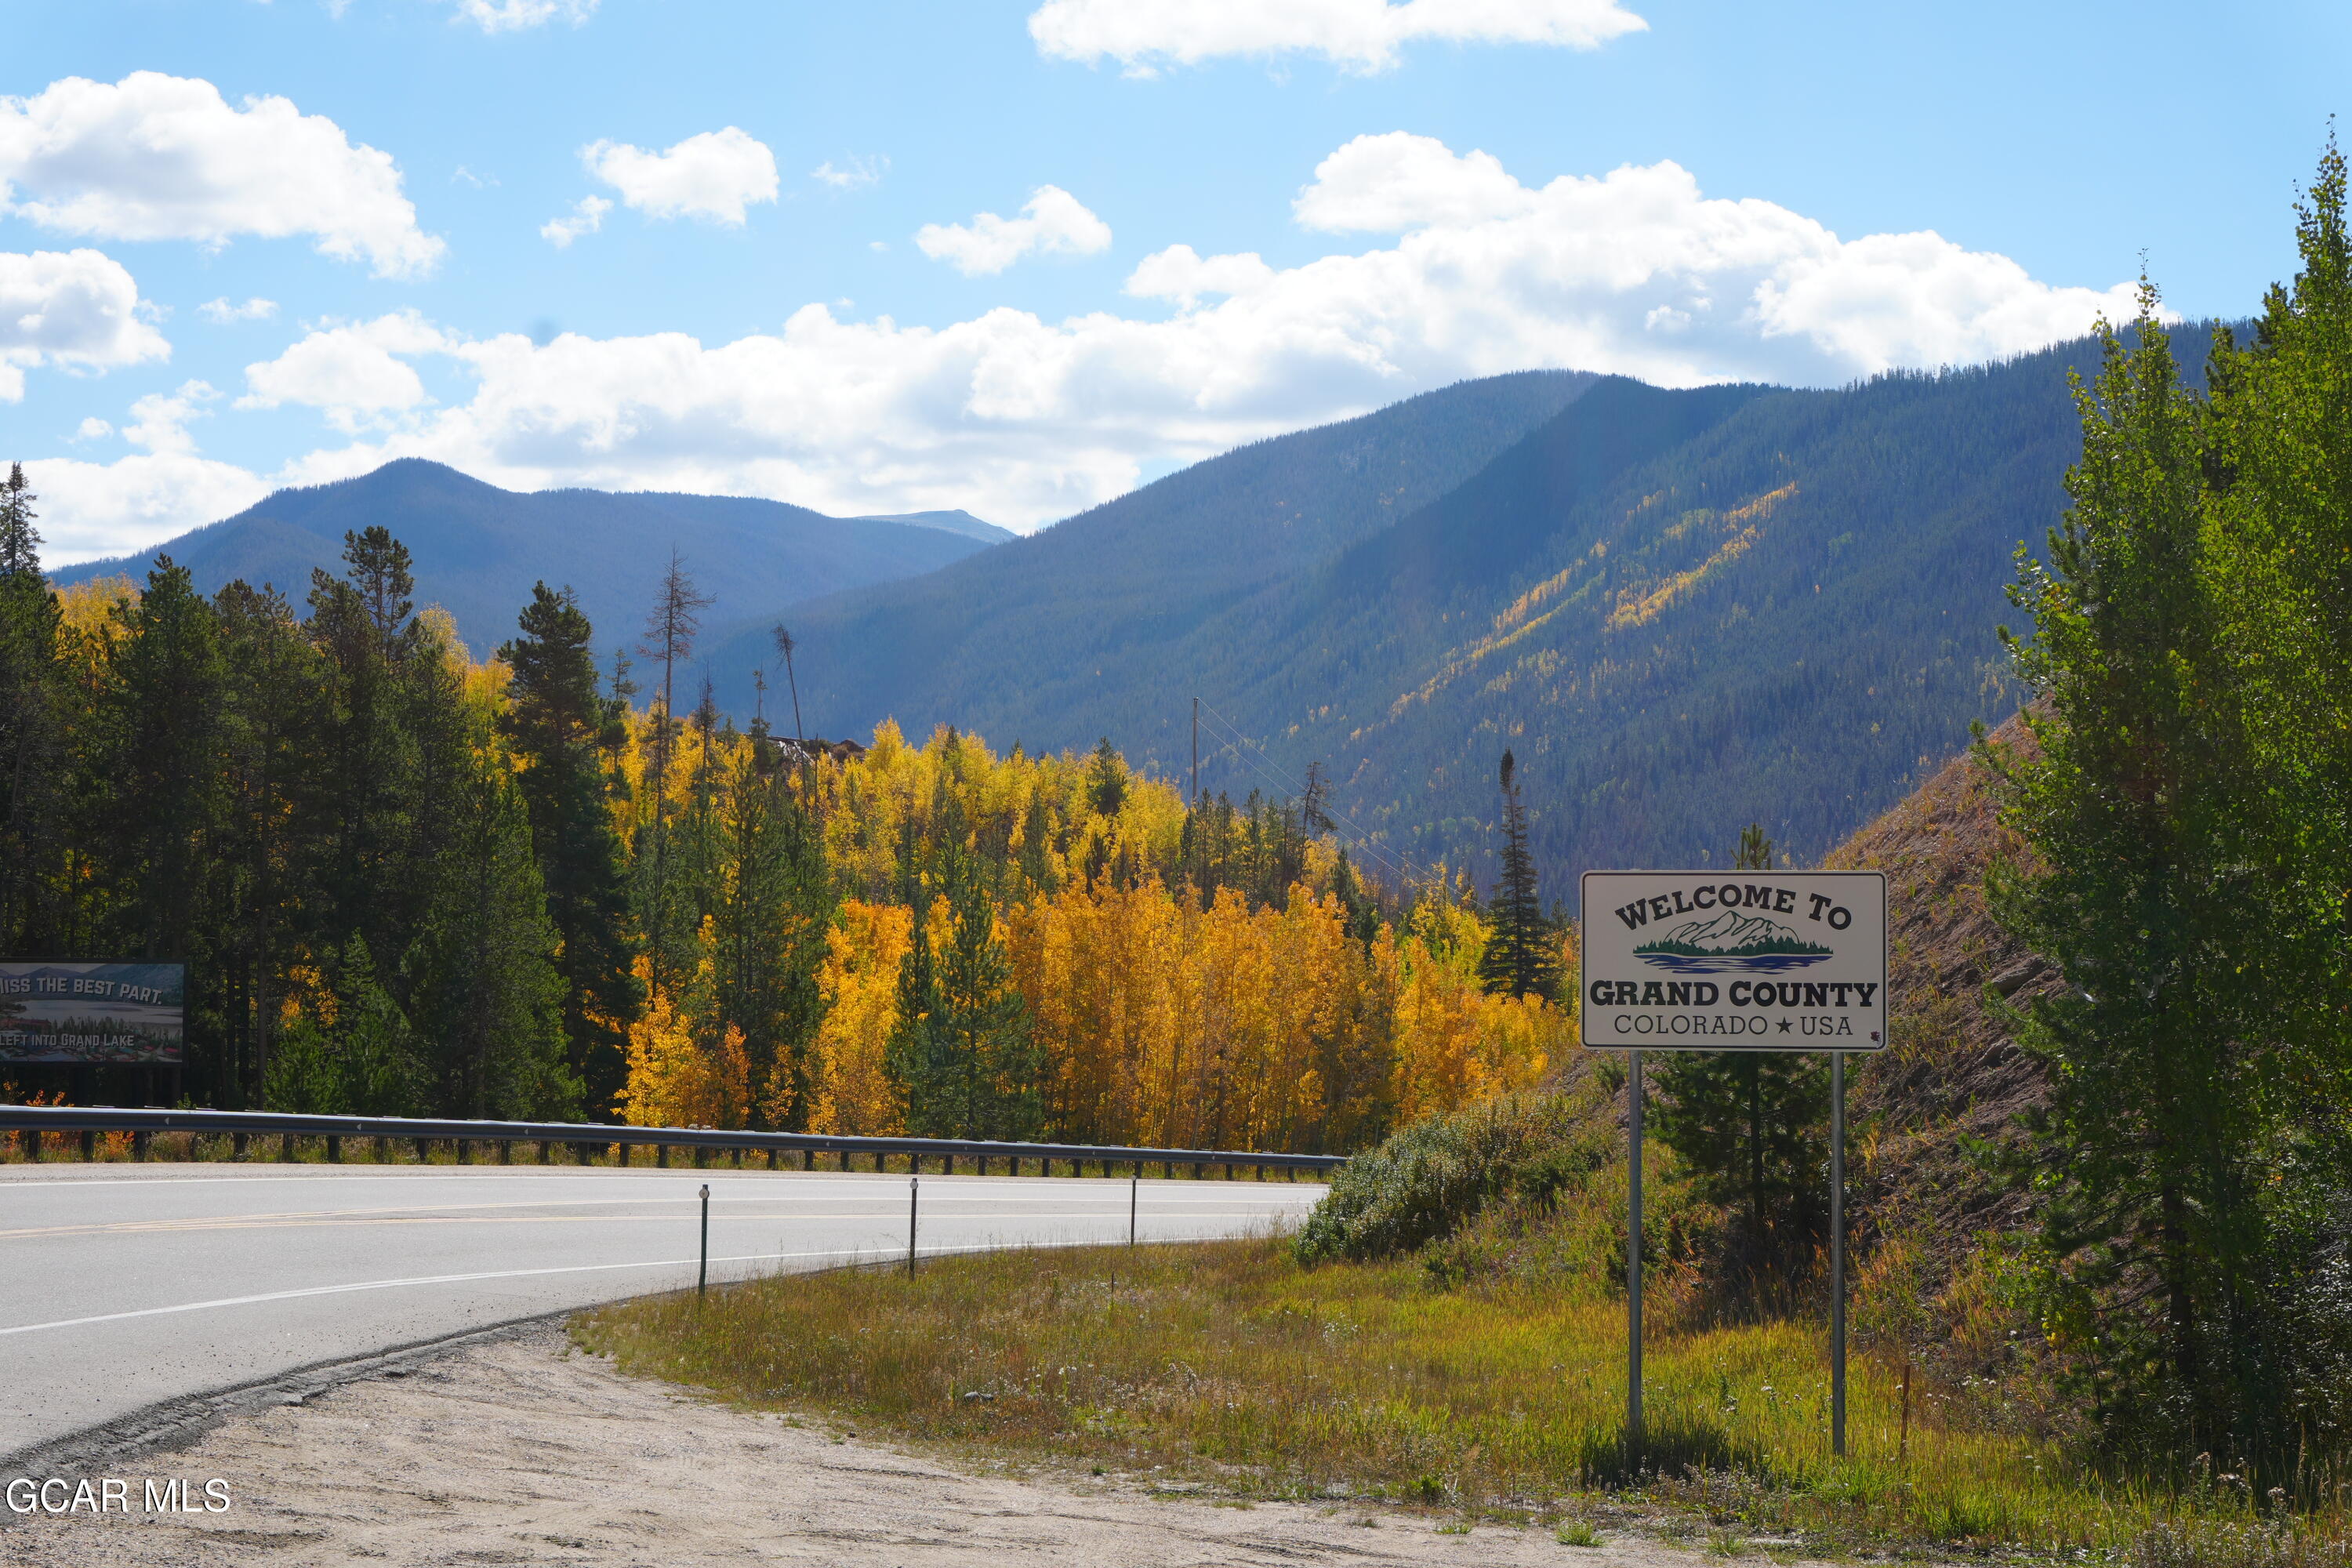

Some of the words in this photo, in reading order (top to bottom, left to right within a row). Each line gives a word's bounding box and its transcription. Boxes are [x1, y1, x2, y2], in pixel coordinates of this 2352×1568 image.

[1614, 884, 1796, 931] WELCOME
[1809, 892, 1852, 931] TO
[37, 978, 67, 993] THE
[74, 979, 115, 996] BEST
[119, 983, 163, 1005] PART.
[1590, 980, 1719, 1007] GRAND
[1729, 980, 1878, 1007] COUNTY
[1614, 1014, 1768, 1036] COLORADO
[1801, 1016, 1853, 1036] USA
[31, 1034, 57, 1046] INTO
[61, 1033, 100, 1047] GRAND
[103, 1033, 134, 1047] LAKE
